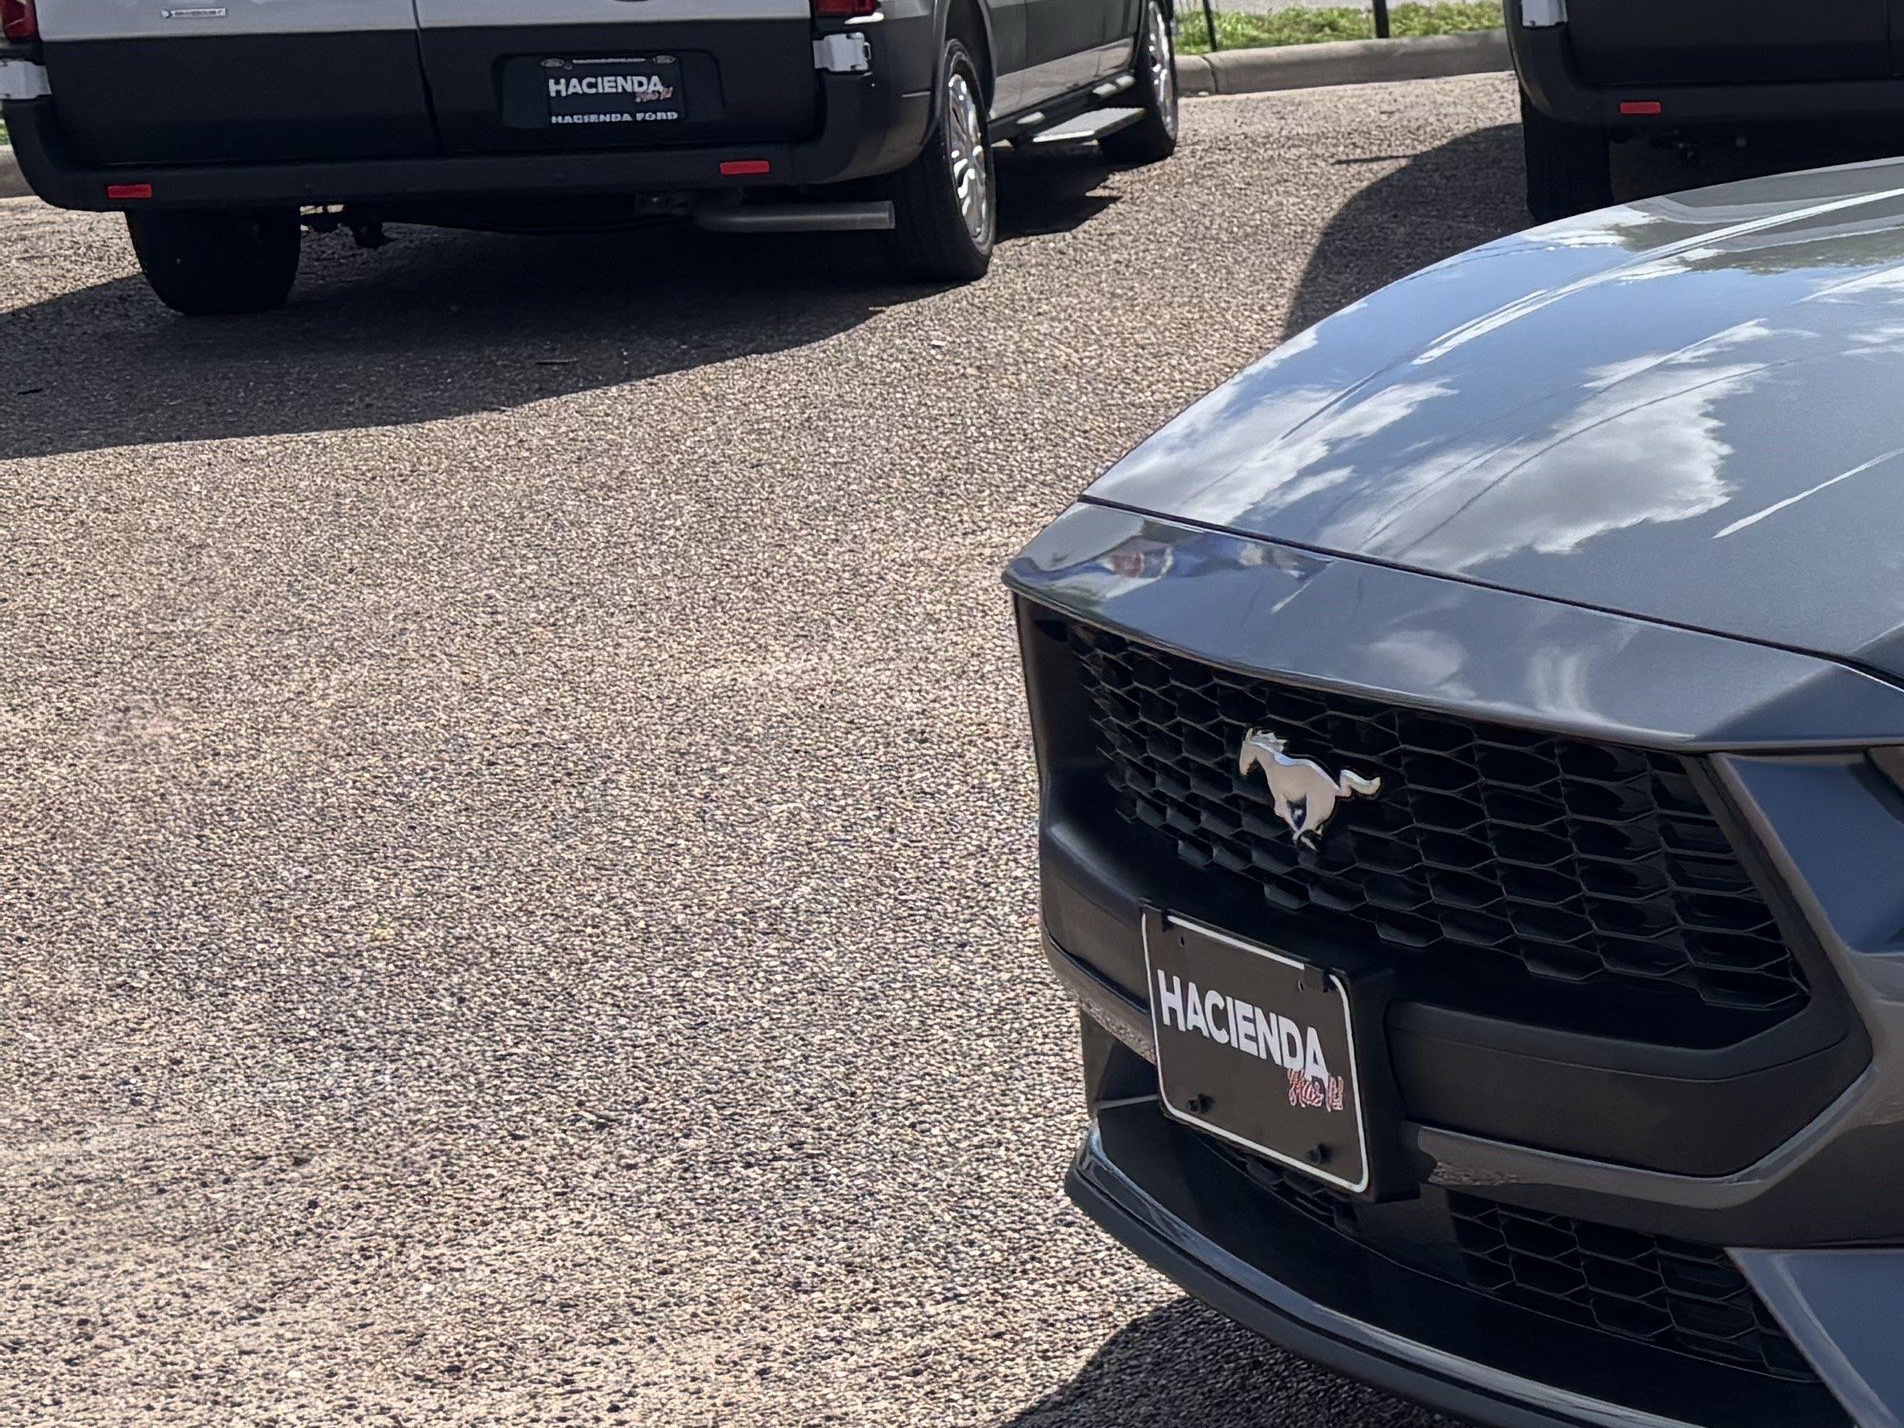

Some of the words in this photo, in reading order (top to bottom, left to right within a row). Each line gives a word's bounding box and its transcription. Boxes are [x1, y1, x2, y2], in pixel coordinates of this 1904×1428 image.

[548, 75, 664, 98] HACIENDA
[551, 113, 633, 124] HACIENDA
[636, 111, 679, 122] FORD
[1157, 969, 1330, 1083] HACIENDA
